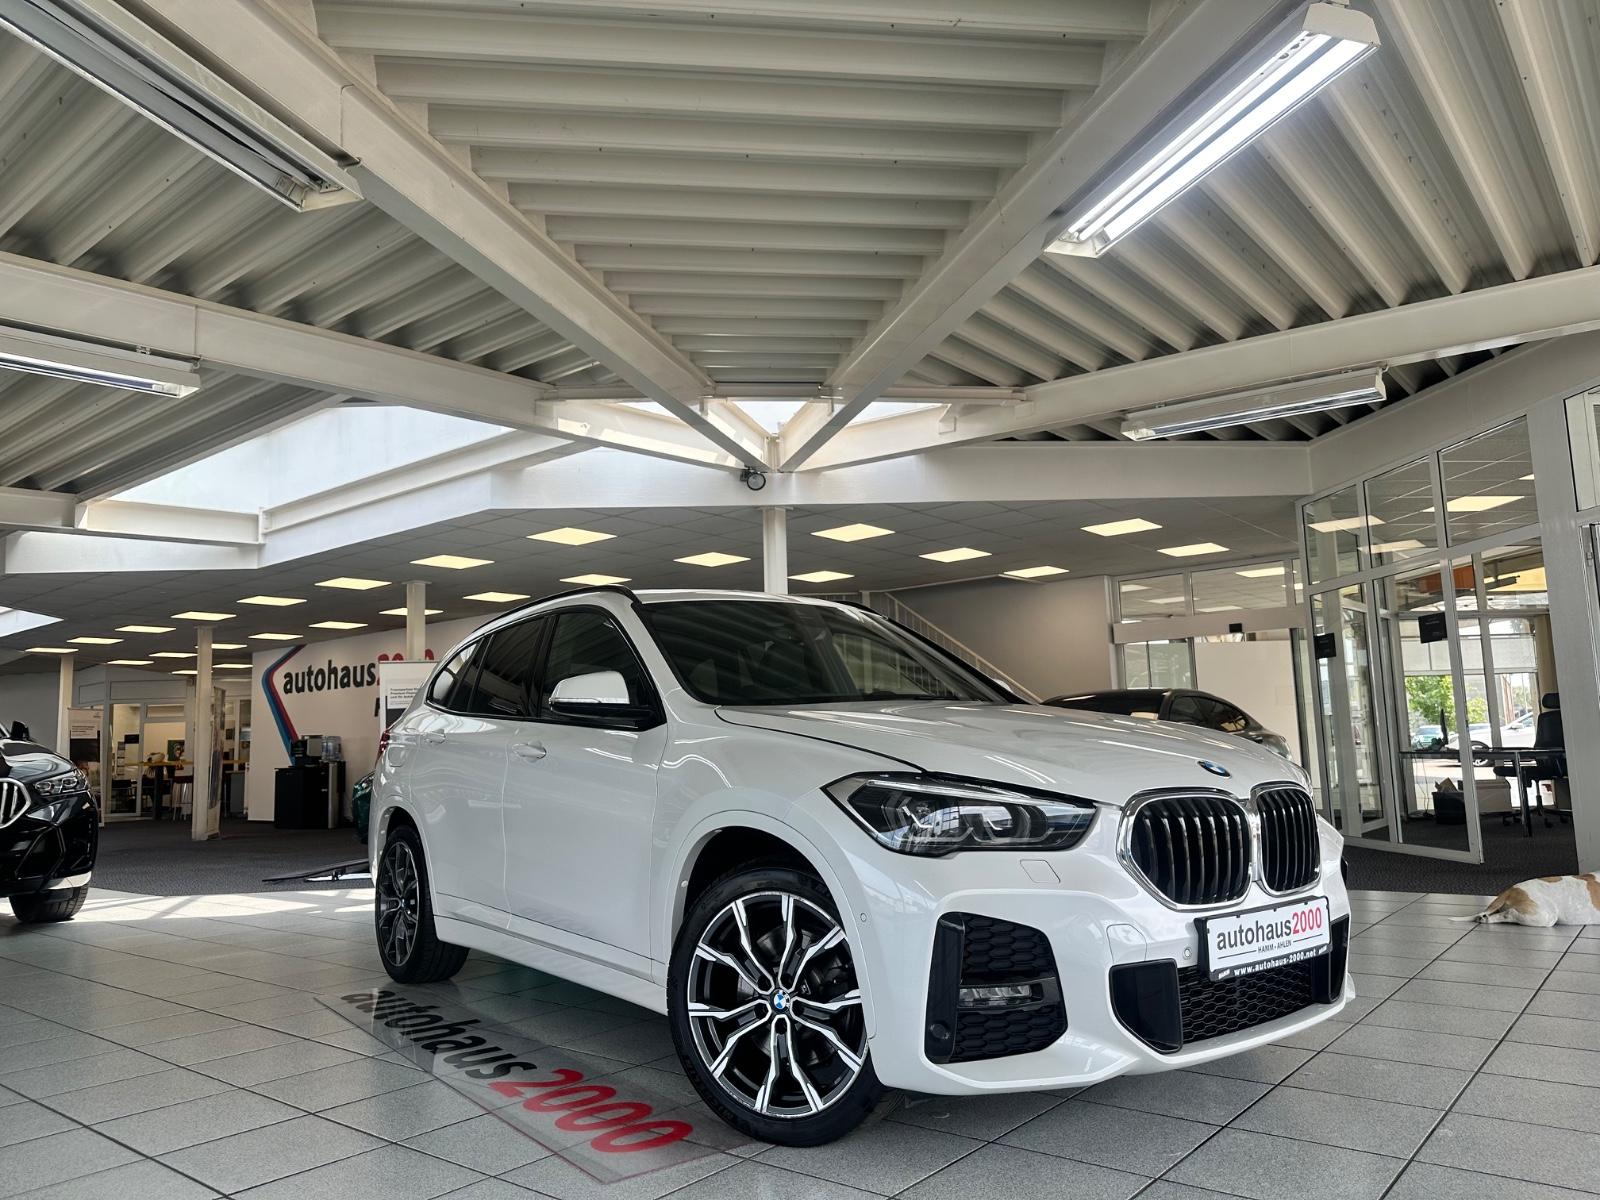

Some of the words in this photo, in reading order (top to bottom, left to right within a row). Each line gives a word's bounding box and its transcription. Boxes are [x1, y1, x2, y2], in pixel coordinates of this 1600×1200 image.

[1217, 906, 1323, 951] autohaus2000
[1234, 948, 1317, 977] www.autohaus-2000.net
[340, 990, 694, 1153] autohaus2000
